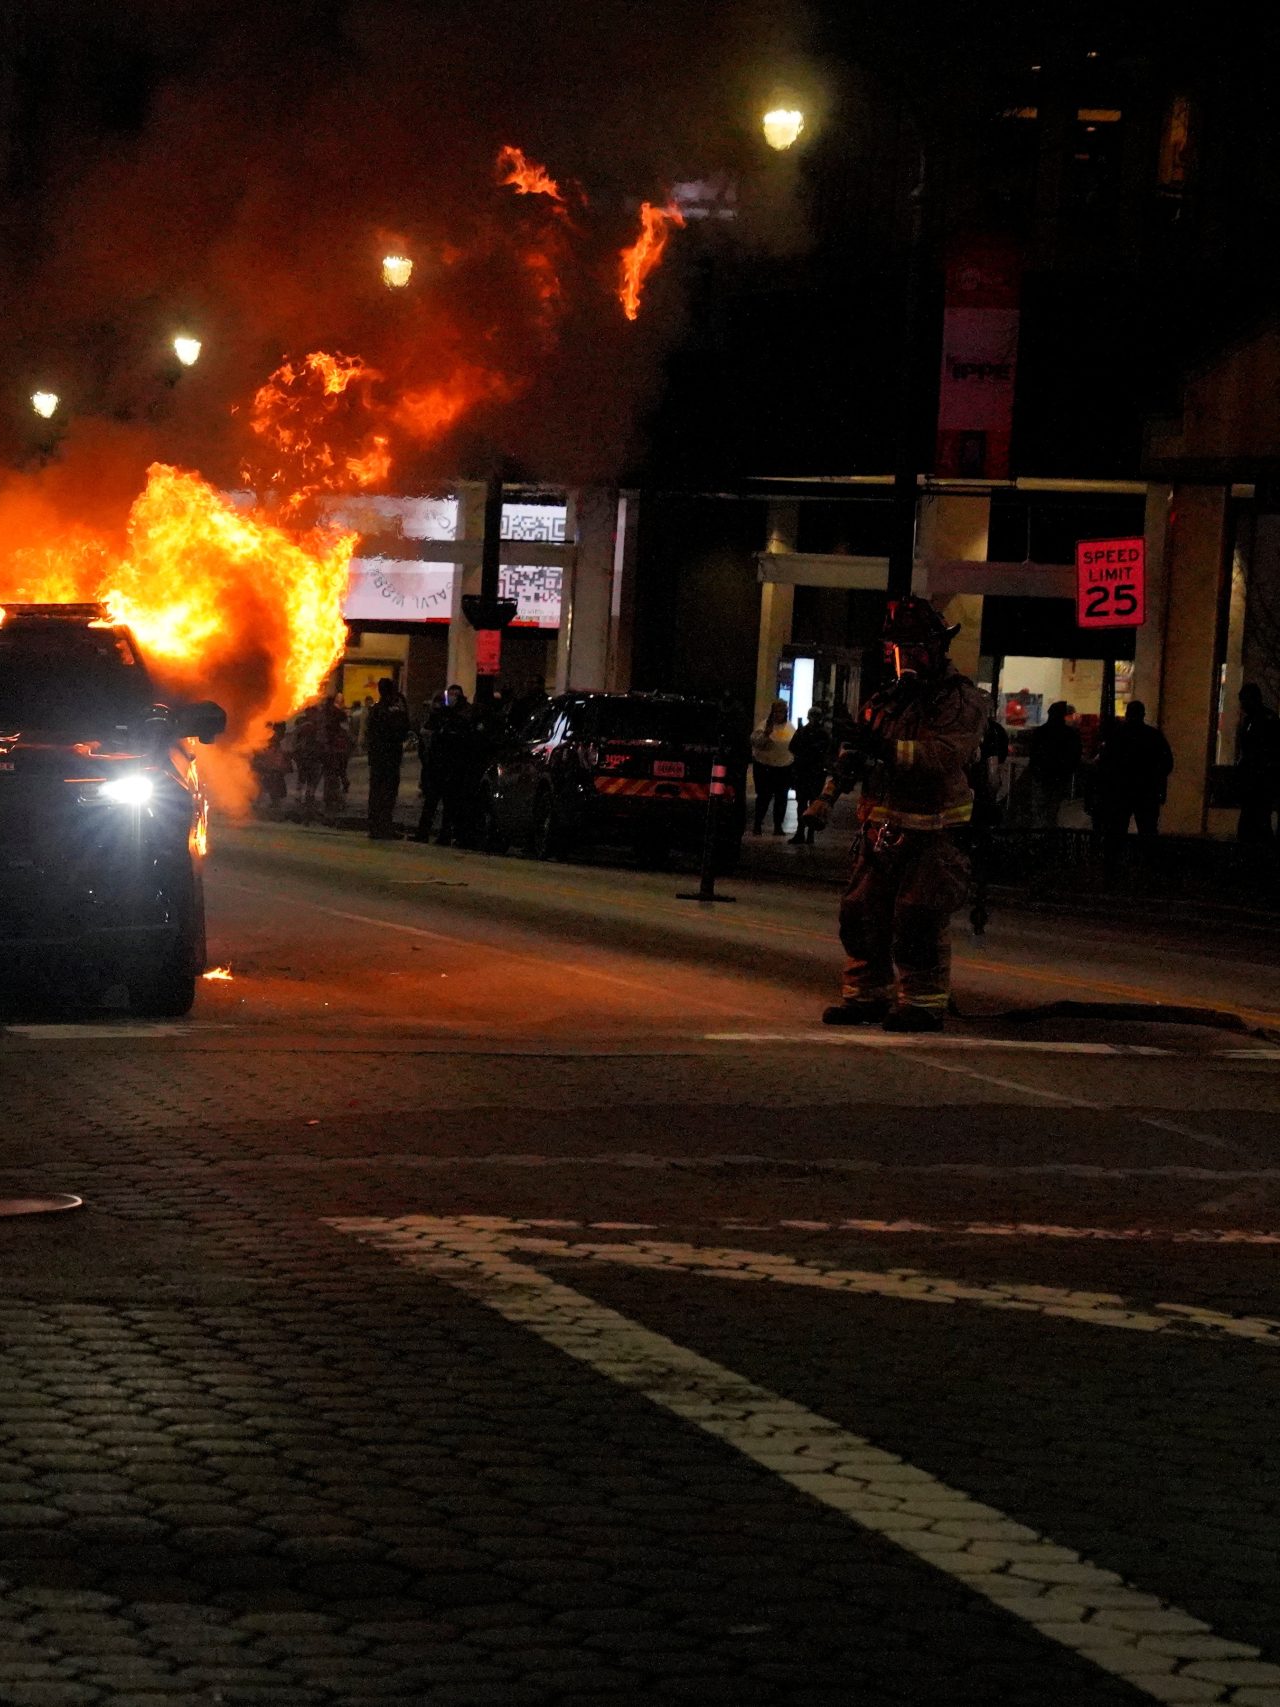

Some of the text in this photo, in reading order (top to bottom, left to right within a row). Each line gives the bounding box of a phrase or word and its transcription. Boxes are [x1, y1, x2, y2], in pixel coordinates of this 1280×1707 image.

[1083, 548, 1140, 564] SPEED
[1088, 566, 1133, 582] LIMIT
[1085, 584, 1137, 617] 25
